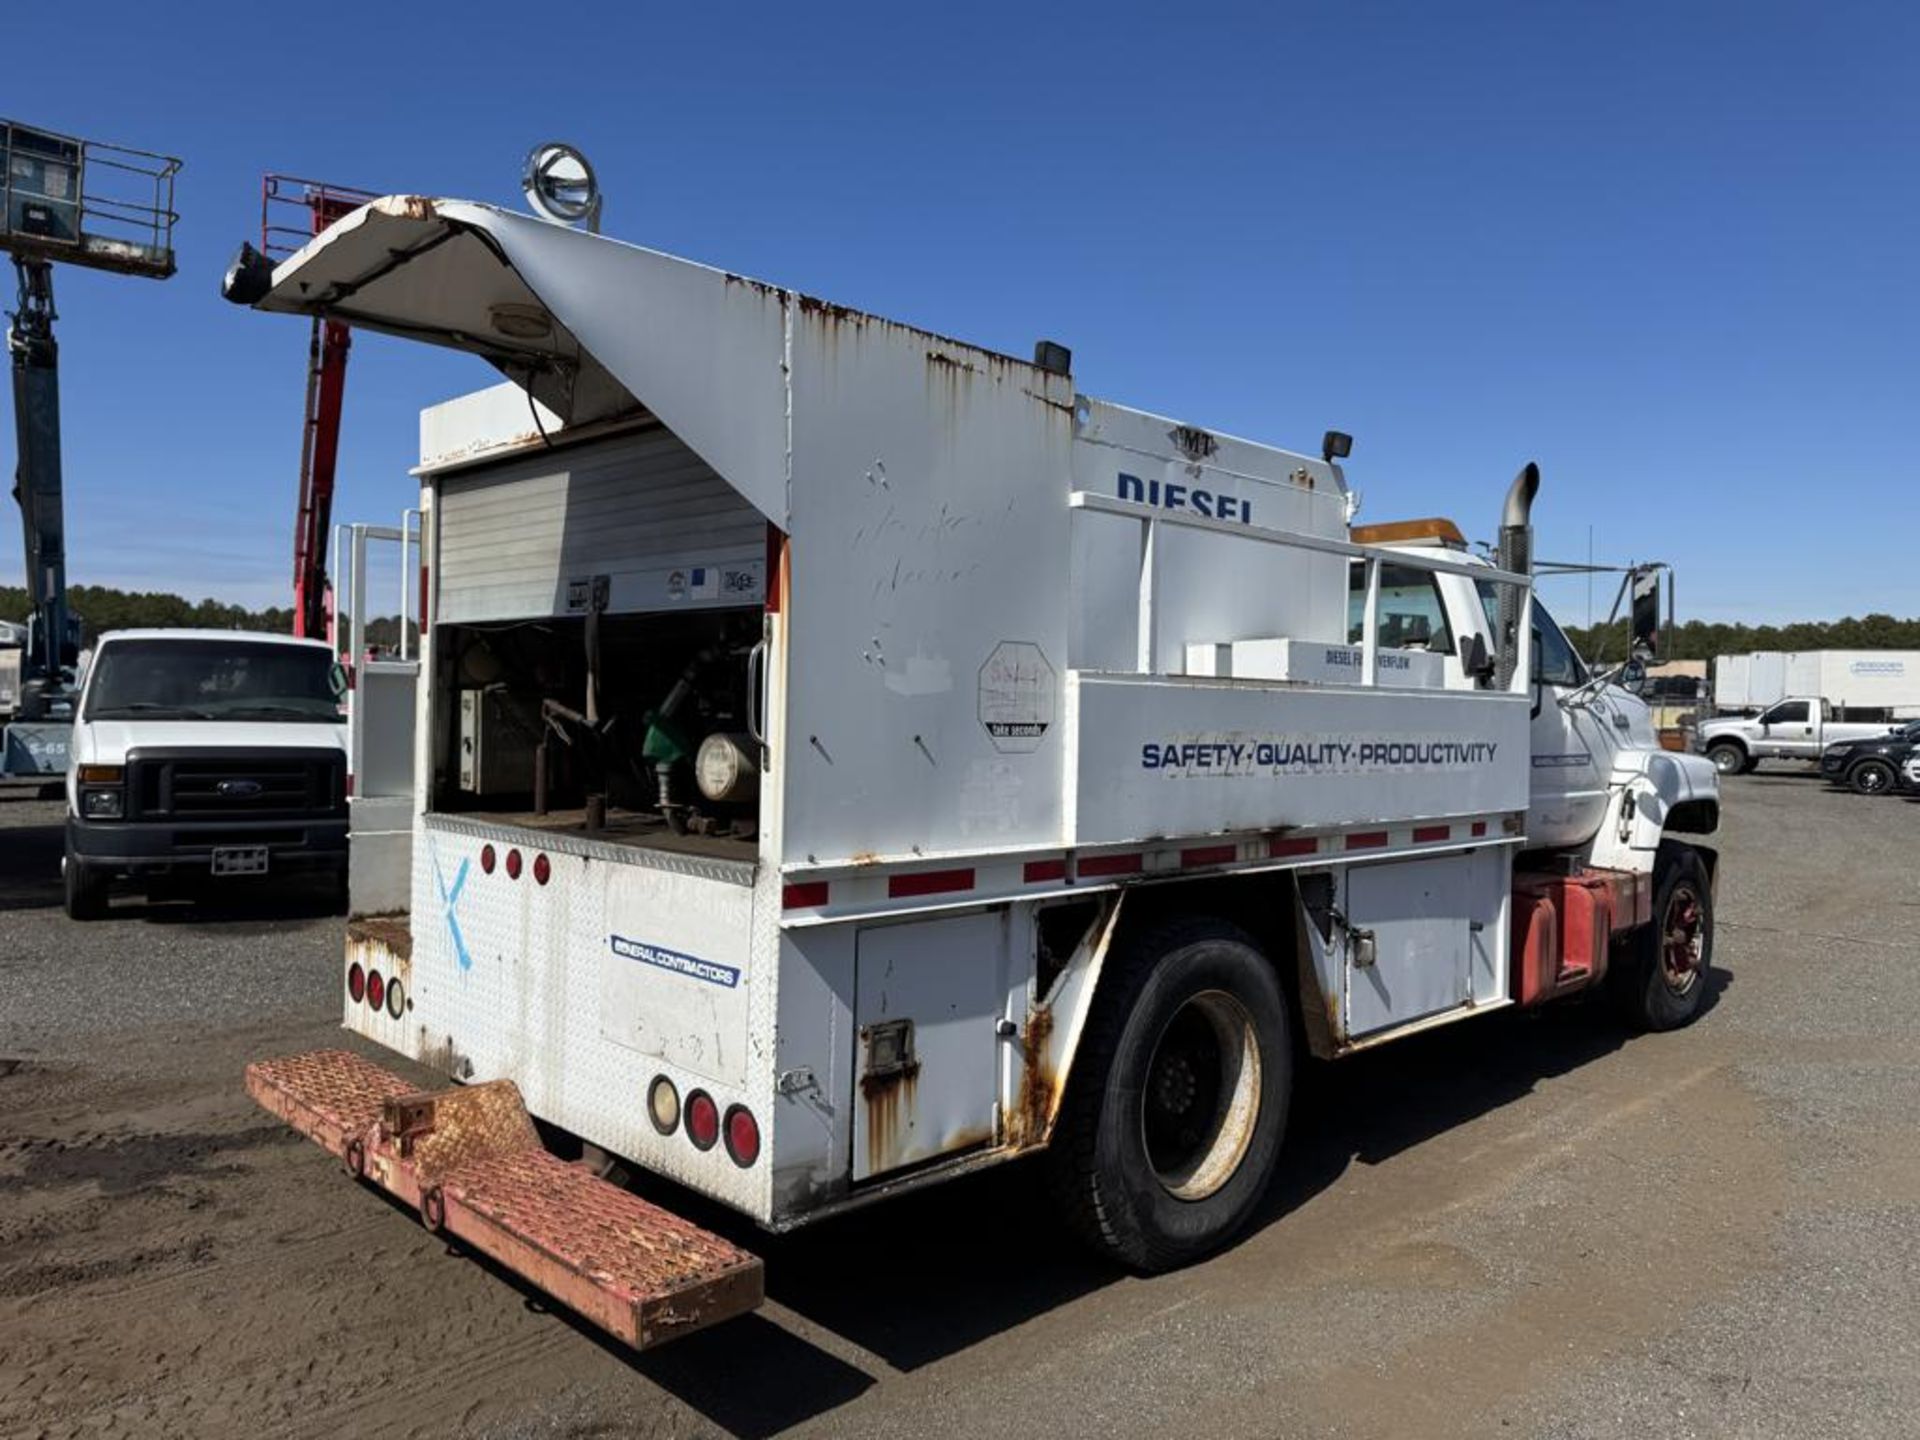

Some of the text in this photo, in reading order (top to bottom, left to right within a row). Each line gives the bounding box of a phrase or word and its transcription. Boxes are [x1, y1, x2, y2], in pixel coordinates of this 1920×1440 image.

[1326, 649, 1352, 666] DIESEL
[1141, 742, 1498, 769] SAFETY QUALITY PRODUCTIVITY
[614, 941, 735, 985] GENERAL CONTRACTORS
